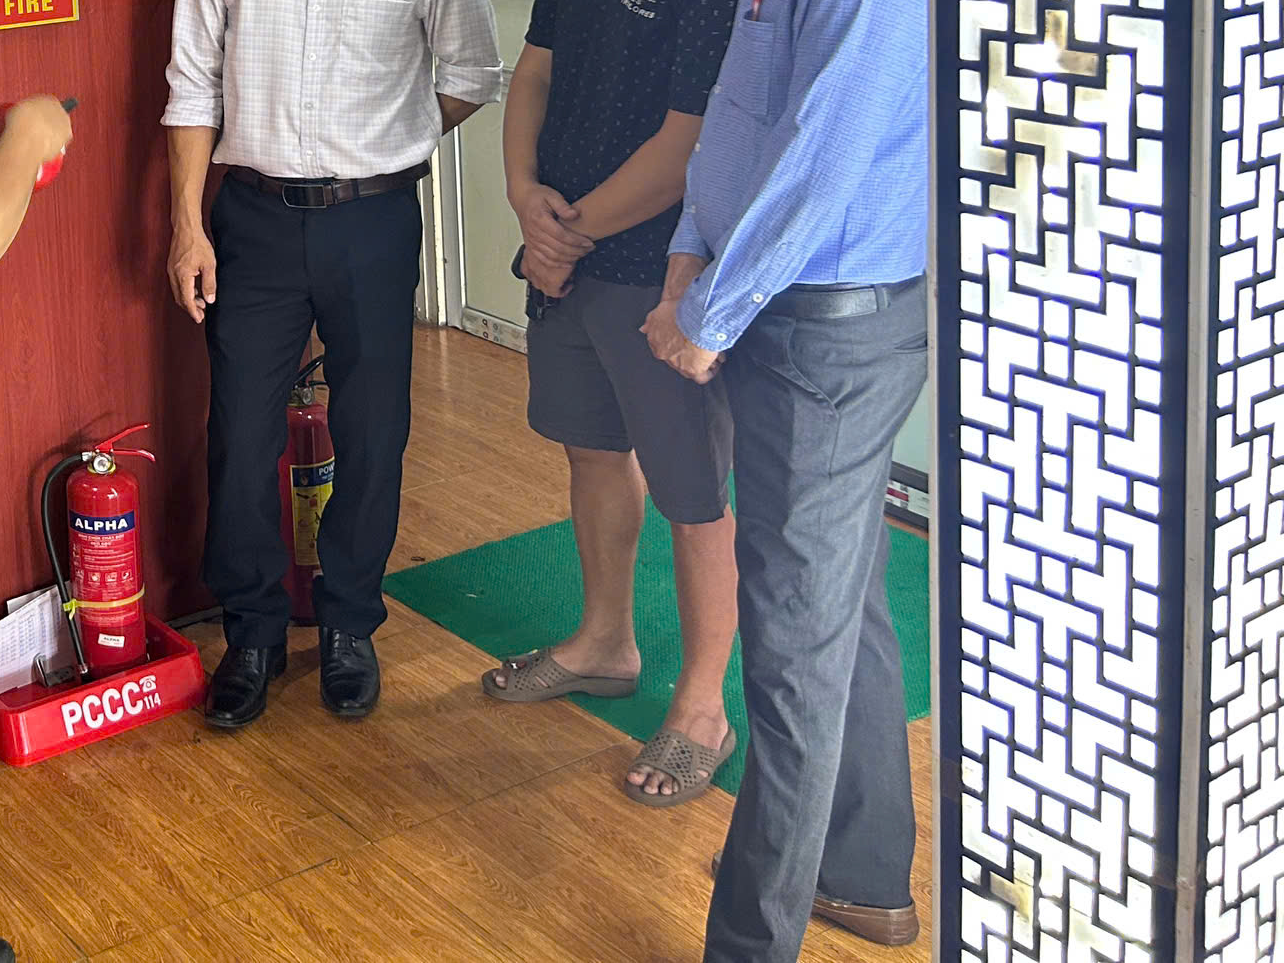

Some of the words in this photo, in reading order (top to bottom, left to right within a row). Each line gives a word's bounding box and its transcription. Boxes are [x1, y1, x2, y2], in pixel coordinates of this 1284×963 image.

[74, 517, 129, 531] ALPHA
[61, 681, 144, 737] PCCC
[143, 692, 162, 710] 114
